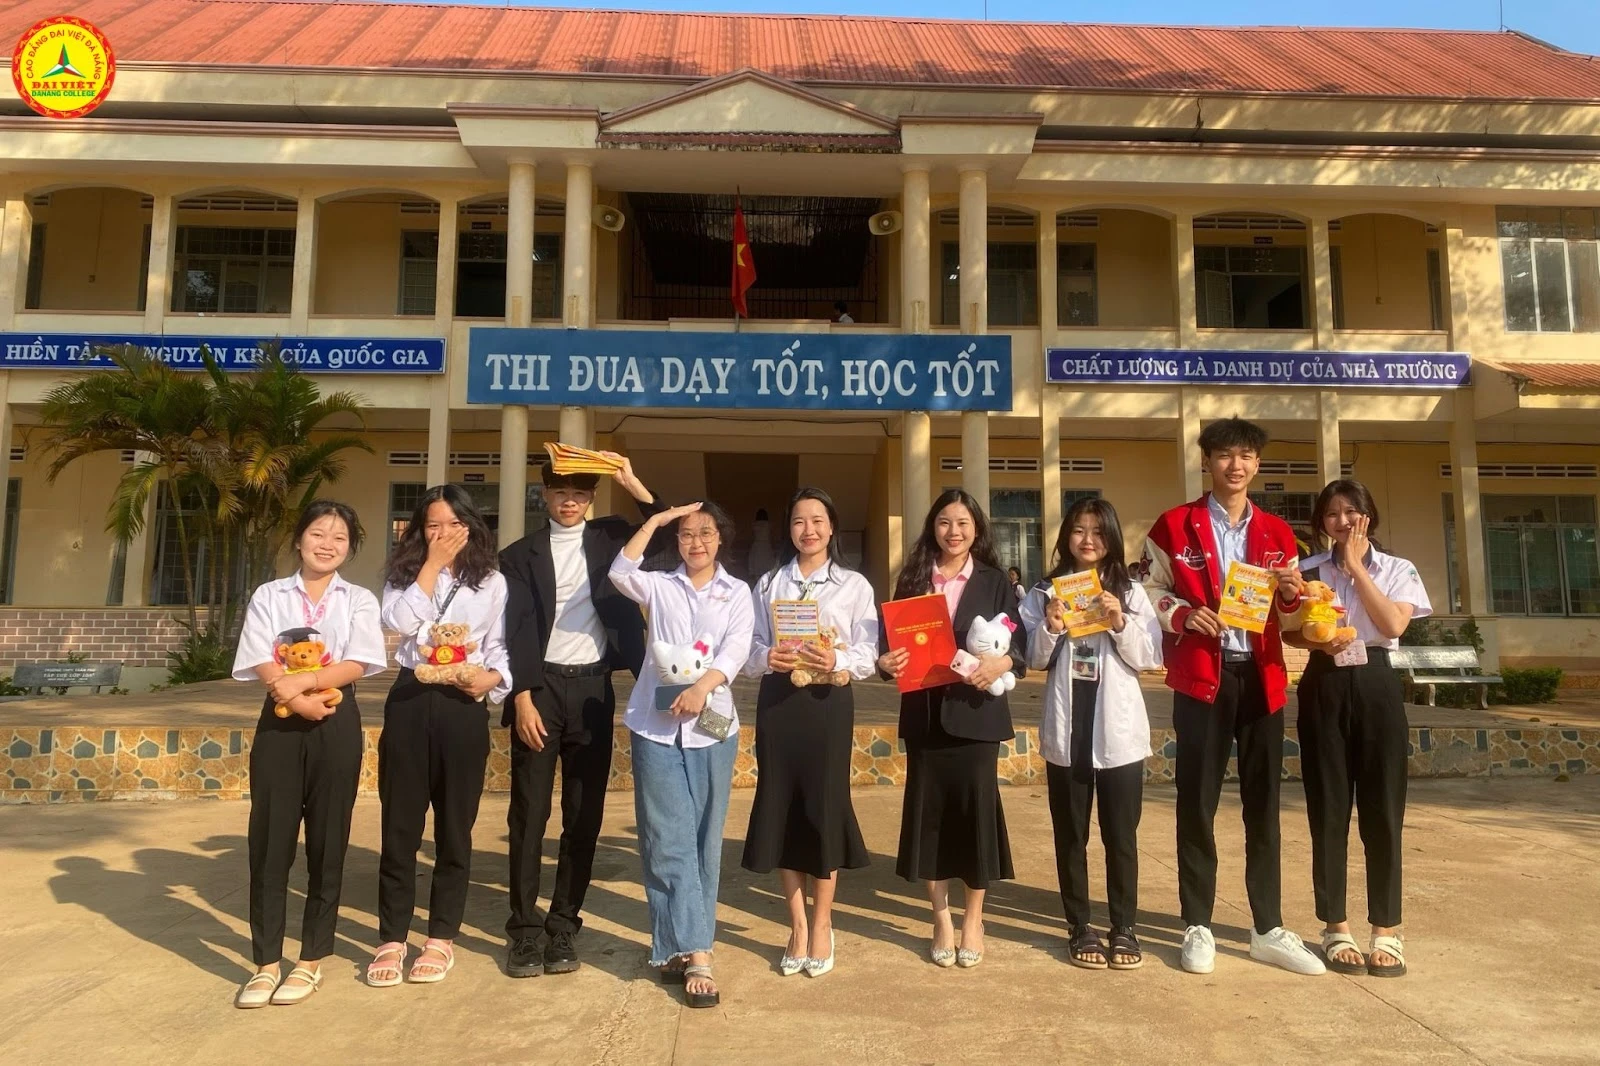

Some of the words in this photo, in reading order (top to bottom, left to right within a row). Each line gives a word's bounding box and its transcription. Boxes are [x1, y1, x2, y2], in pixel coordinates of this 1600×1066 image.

[5, 335, 60, 361] HIỀN
[279, 342, 323, 365] CỦA
[328, 342, 386, 369] QUỐC
[392, 349, 429, 365] GIA
[1062, 352, 1113, 375] CHẤT
[1118, 357, 1179, 379] LƯỢNG
[1184, 356, 1209, 377] LÀ
[1213, 360, 1264, 377] DANH
[1269, 359, 1295, 381] DỰ
[1300, 357, 1338, 378] CỦA
[1342, 358, 1380, 379] NHÀ
[1384, 359, 1458, 380] TRƯỜNG
[485, 353, 551, 391] THI
[568, 355, 645, 393] ĐUA
[660, 356, 737, 403] DẠY
[752, 339, 830, 401] TỐT,
[841, 359, 918, 405] HỌC
[928, 342, 1001, 397] TỐT
